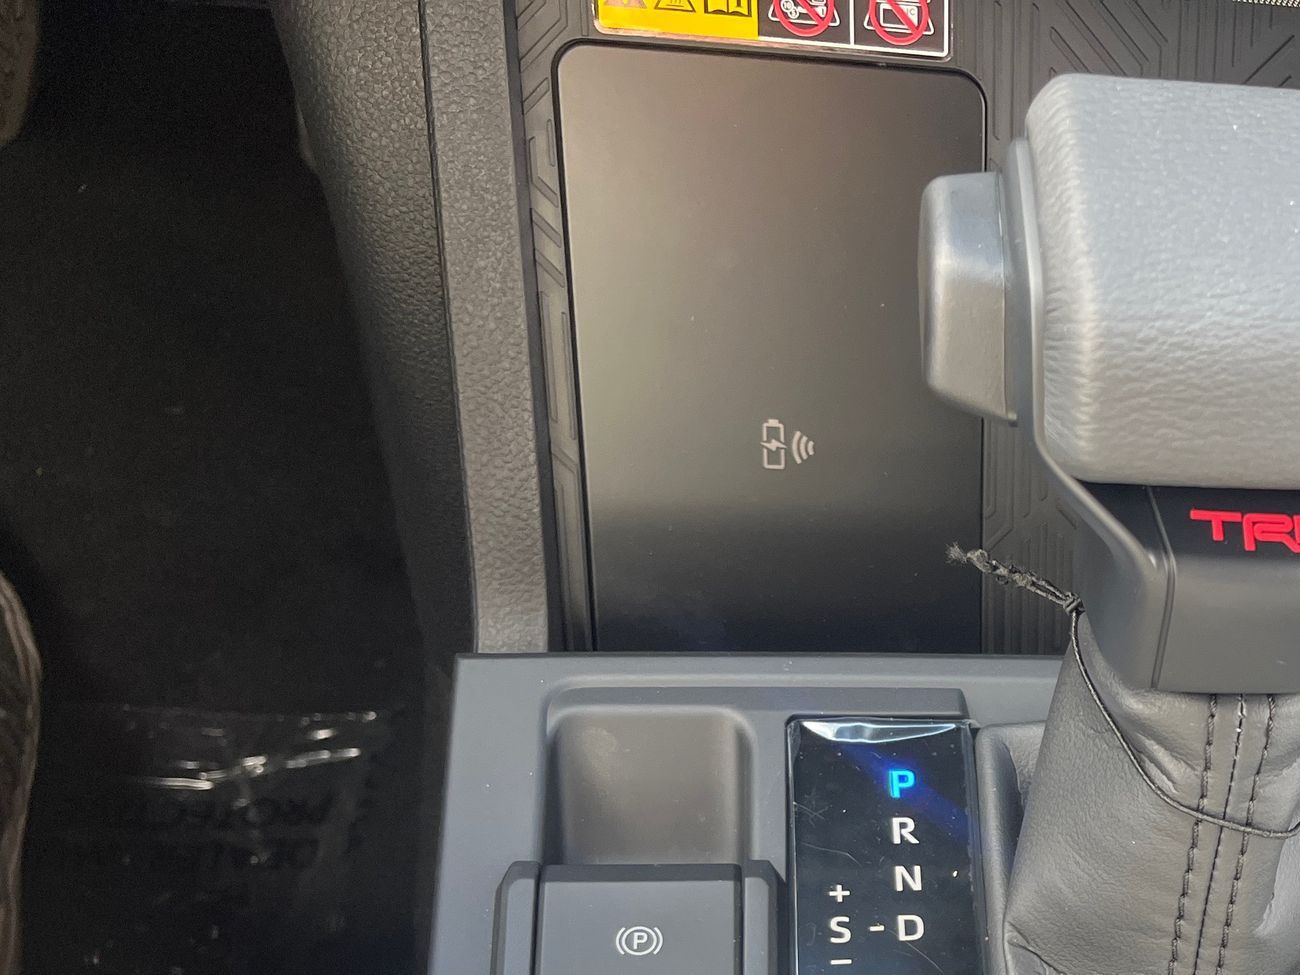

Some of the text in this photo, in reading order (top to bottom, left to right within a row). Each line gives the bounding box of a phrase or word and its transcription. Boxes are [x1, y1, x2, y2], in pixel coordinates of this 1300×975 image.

[890, 769, 916, 798] P
[892, 817, 919, 844] R
[895, 865, 922, 892] N
[830, 916, 851, 943] S
[897, 914, 924, 942] D
